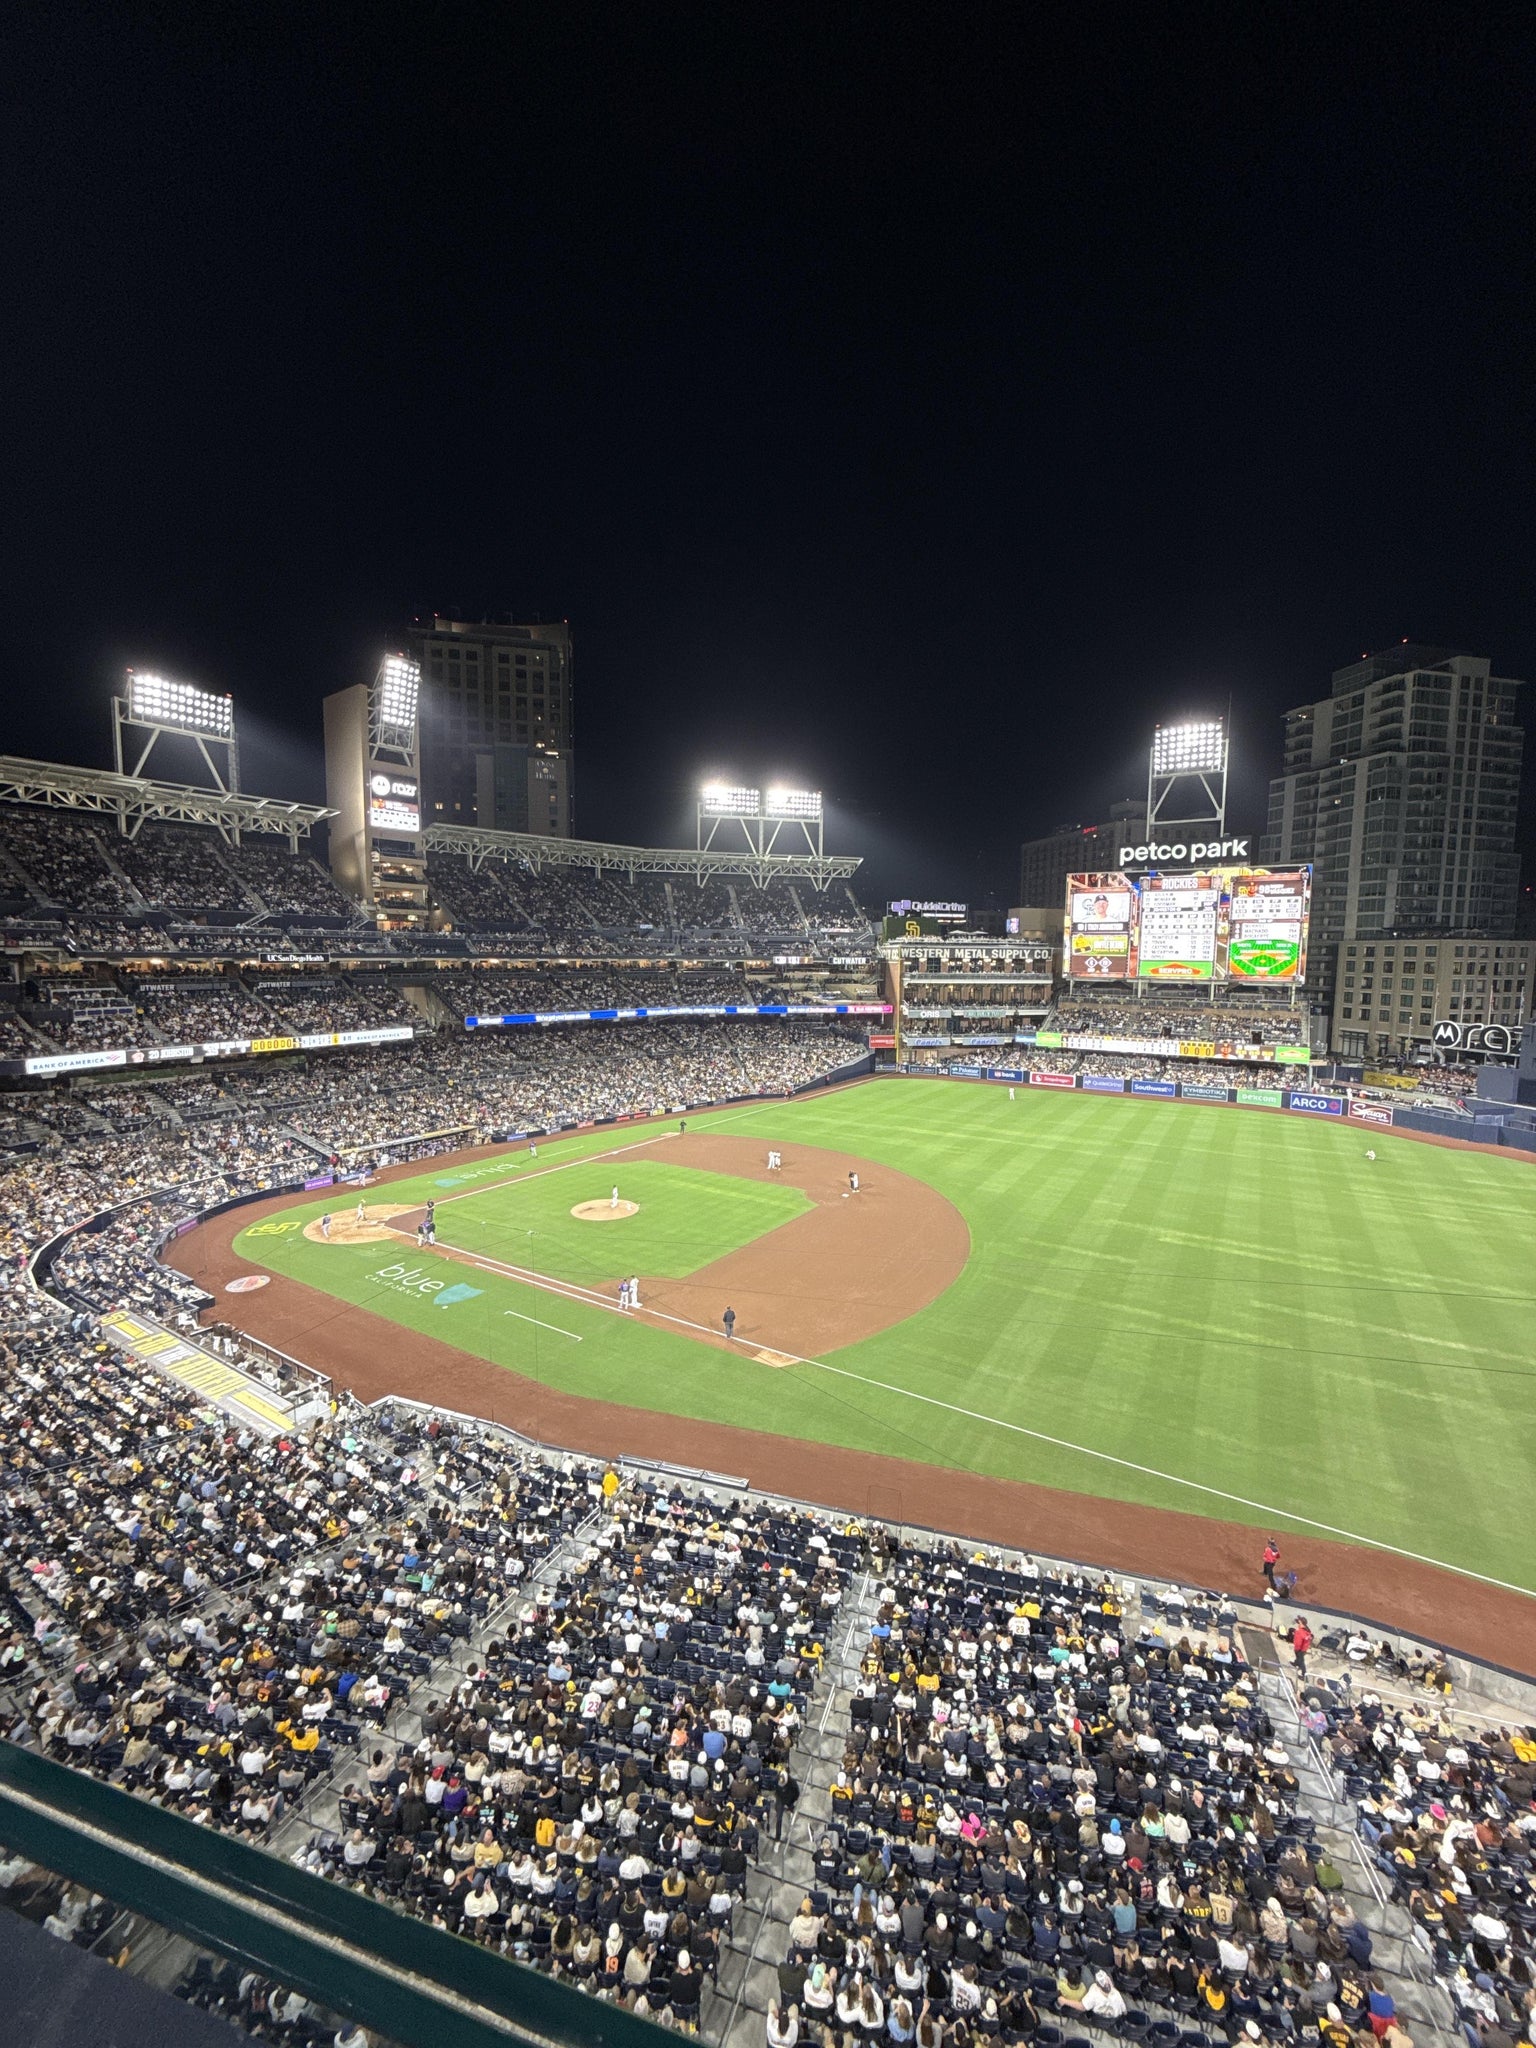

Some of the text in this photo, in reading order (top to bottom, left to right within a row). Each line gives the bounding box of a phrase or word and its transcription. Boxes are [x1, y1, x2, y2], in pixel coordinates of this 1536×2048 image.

[1120, 838, 1249, 866] petco park
[1162, 878, 1198, 889] ROCKIES
[912, 902, 967, 911] QuidelOrtho
[901, 949, 1051, 959] WESTERN METAL SUPPLY CO.
[289, 955, 306, 964] Diego
[305, 955, 324, 963] Health
[1158, 967, 1192, 975] SERVPRO
[920, 1010, 940, 1018] ORIS
[69, 1058, 105, 1066] AMERICA
[1134, 1084, 1168, 1092] Southwest
[1184, 1087, 1226, 1096] SYMBIOTIKA
[1242, 1094, 1277, 1103] dexcom
[1292, 1097, 1327, 1110] ARCO
[1352, 1104, 1387, 1120] Sycuan
[375, 1262, 445, 1293] blue
[365, 1275, 422, 1298] CALIFORNIA
[1185, 1868, 1195, 1877] 13
[1216, 1907, 1227, 1921] 13
[606, 1957, 619, 1973] 19
